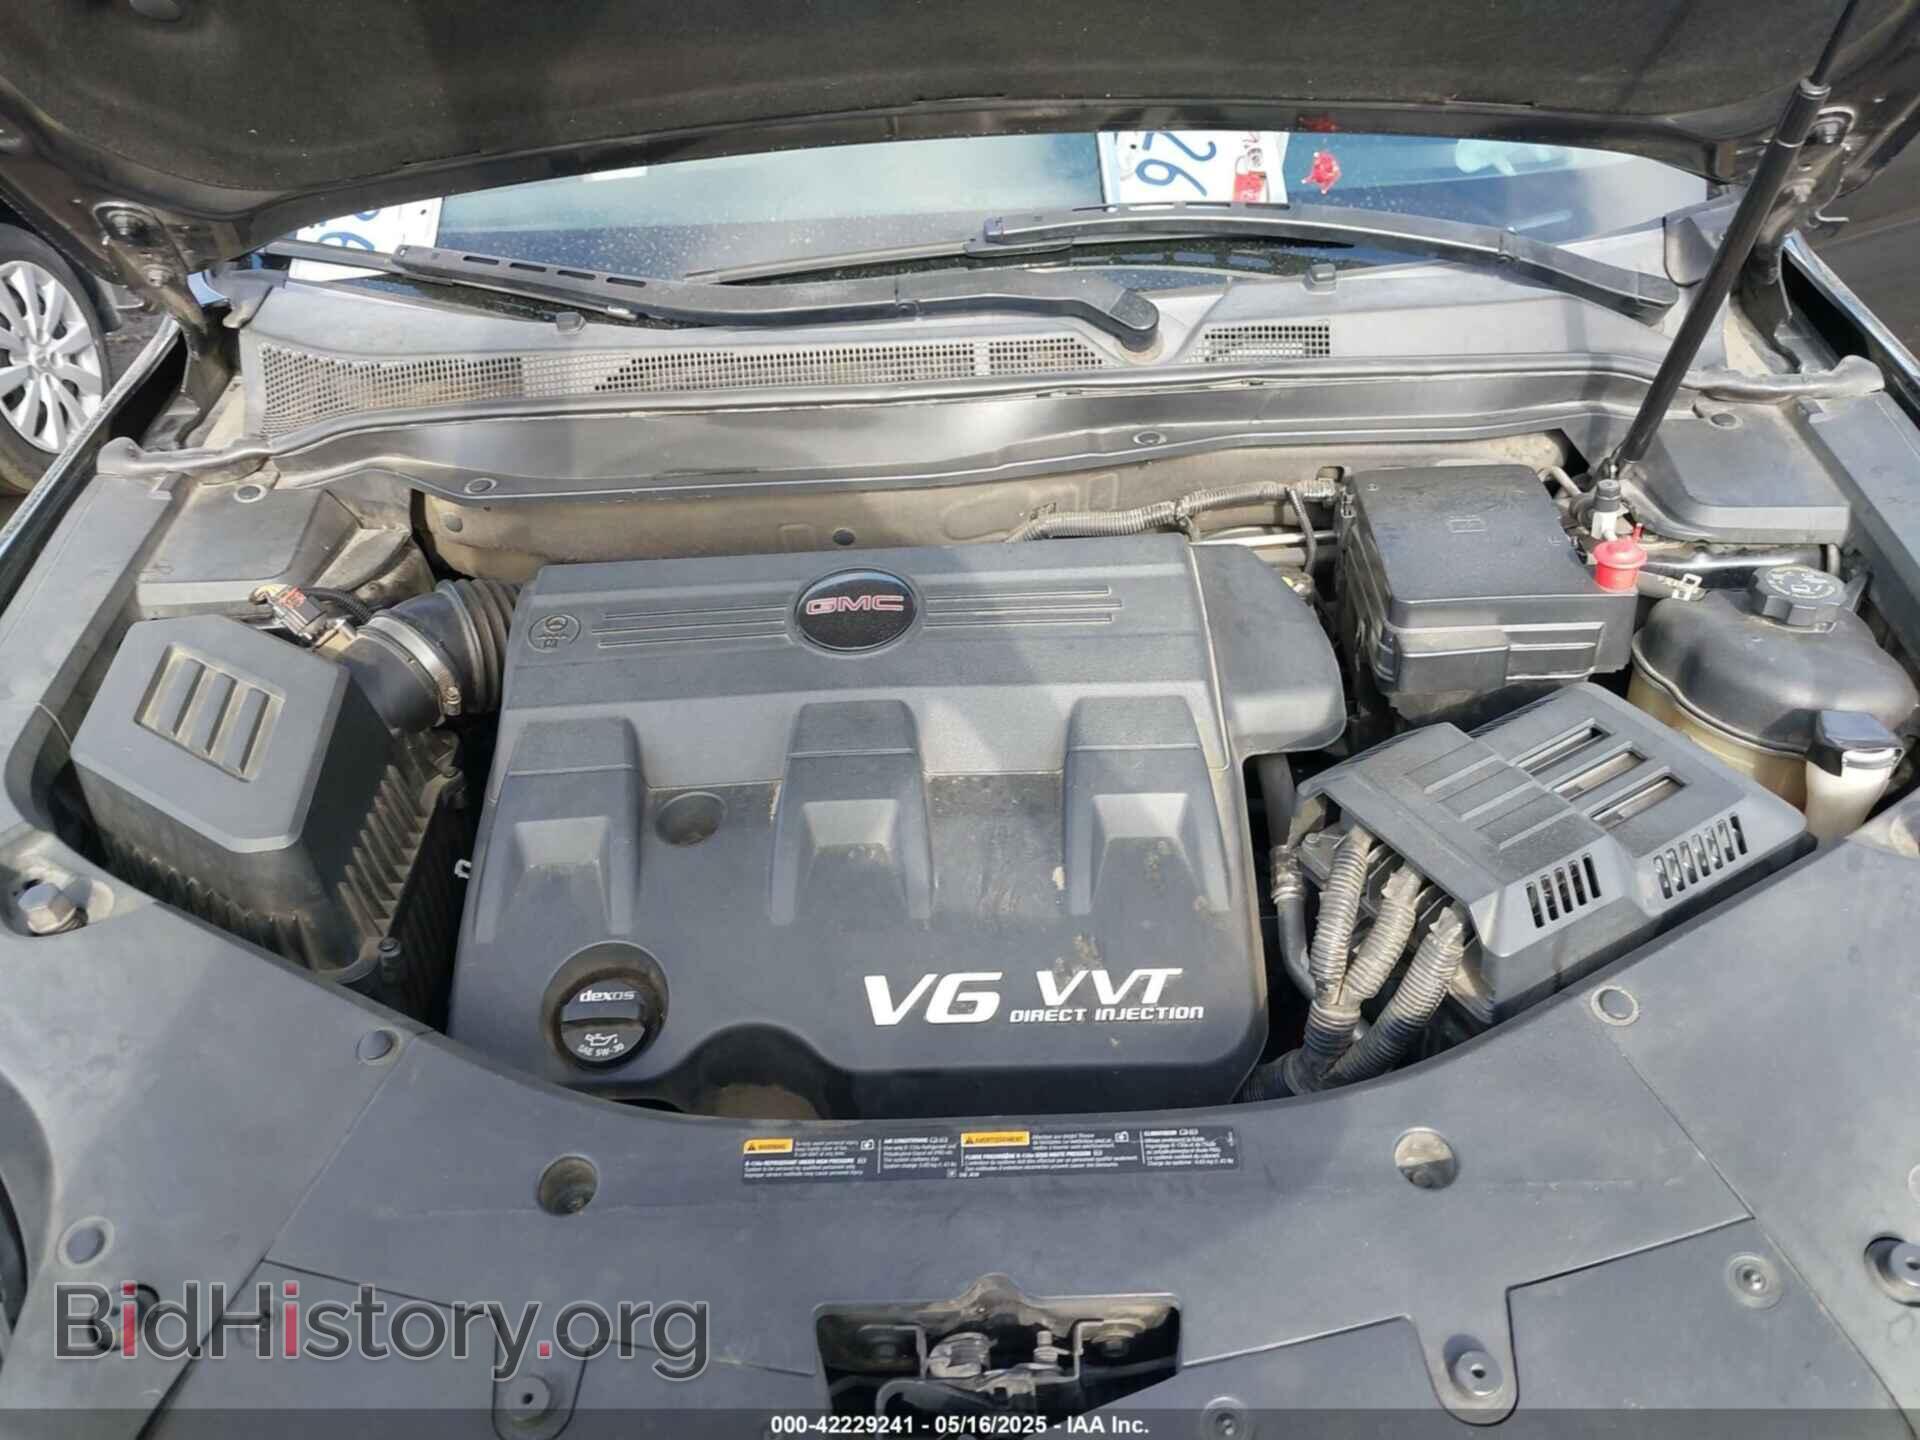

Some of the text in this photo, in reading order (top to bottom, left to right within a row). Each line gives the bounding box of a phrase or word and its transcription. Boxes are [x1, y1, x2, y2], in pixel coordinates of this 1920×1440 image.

[806, 595, 904, 615] GMC
[579, 990, 635, 1002] dexos
[864, 967, 1184, 1026] V6 VVT
[1008, 1005, 1205, 1023] DIRECT INJECTION
